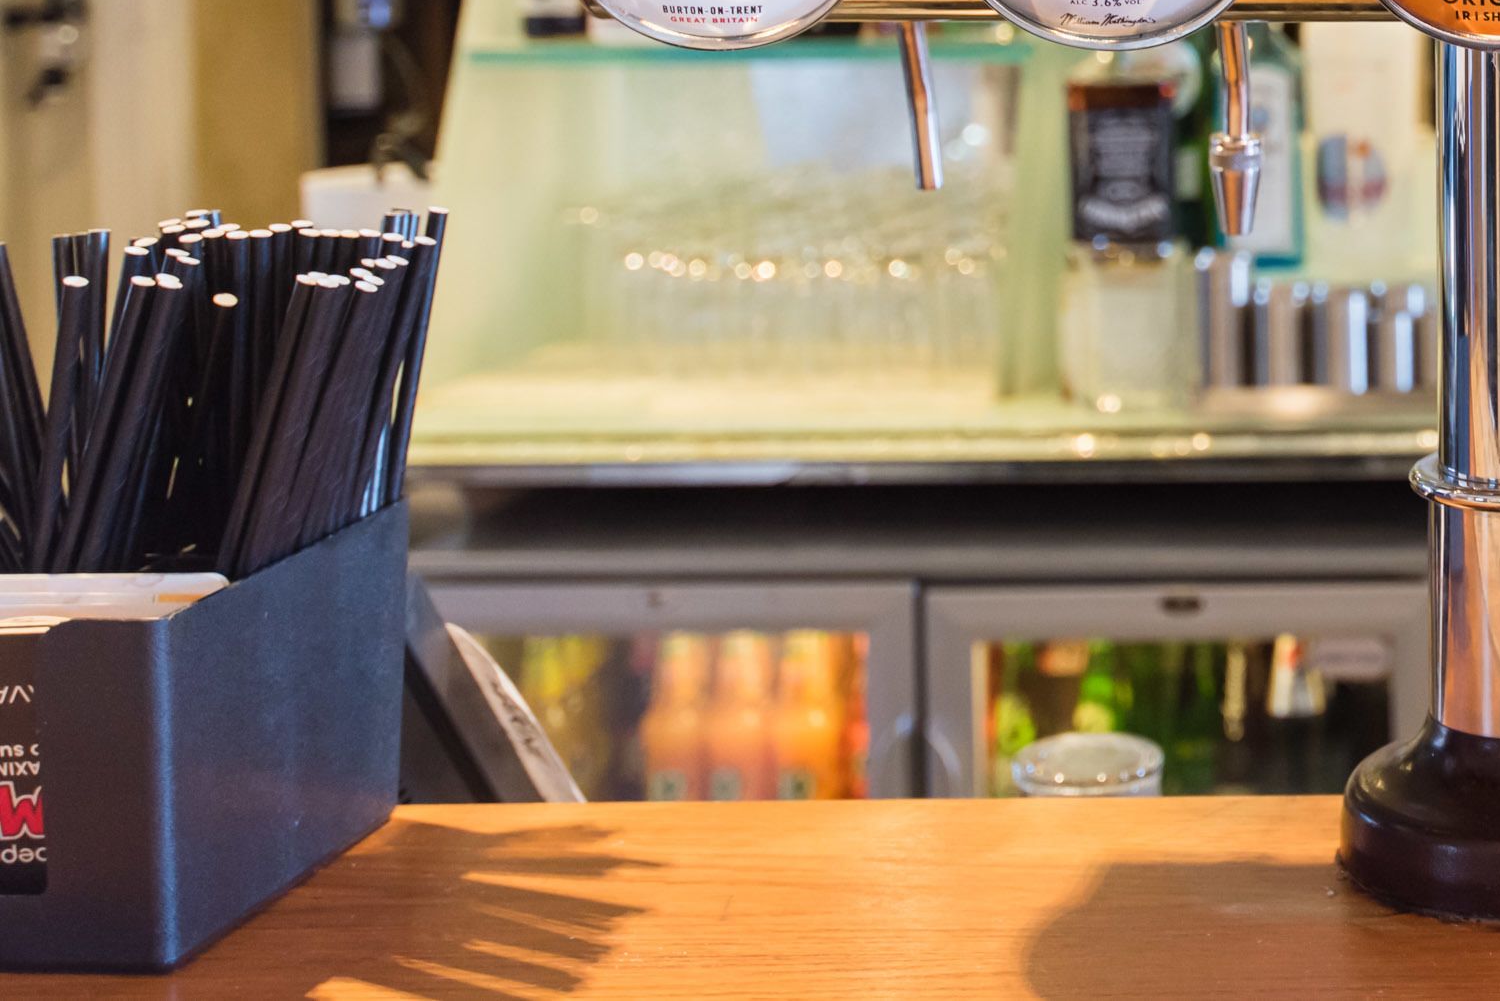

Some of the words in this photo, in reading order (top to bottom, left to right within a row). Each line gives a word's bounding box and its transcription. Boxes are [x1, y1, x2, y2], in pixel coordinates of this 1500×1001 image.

[662, 4, 763, 15] BURTON-ON-TRENT
[712, 16, 759, 24] BRITAIN
[1455, 10, 1500, 21] IRISH
